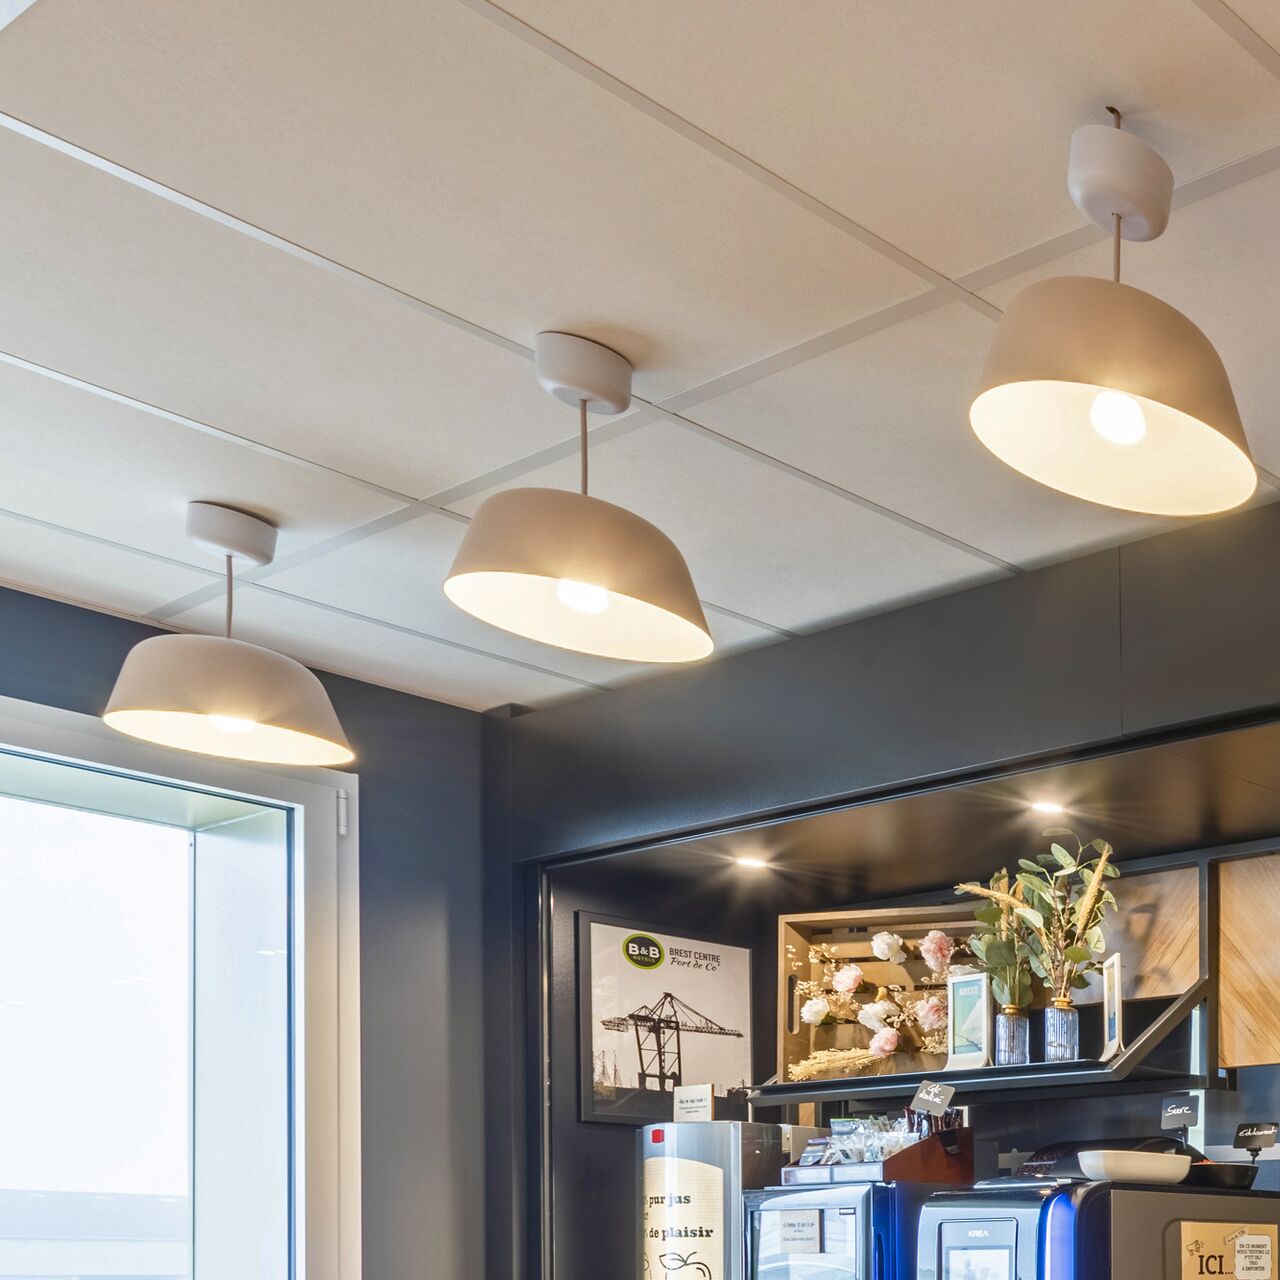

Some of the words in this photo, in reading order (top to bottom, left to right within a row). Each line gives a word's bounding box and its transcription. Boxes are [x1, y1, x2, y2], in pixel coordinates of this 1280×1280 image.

[628, 942, 661, 960] B&B
[669, 947, 692, 959] BREST
[693, 952, 721, 964] CENTRE
[633, 955, 656, 963] HOTELS
[670, 957, 691, 968] Port
[692, 958, 703, 970] de
[1165, 1104, 1192, 1116] Sucre
[649, 1196, 666, 1208] pur
[668, 1193, 691, 1208] jus
[649, 1227, 659, 1238] de
[661, 1226, 714, 1242] plaisir
